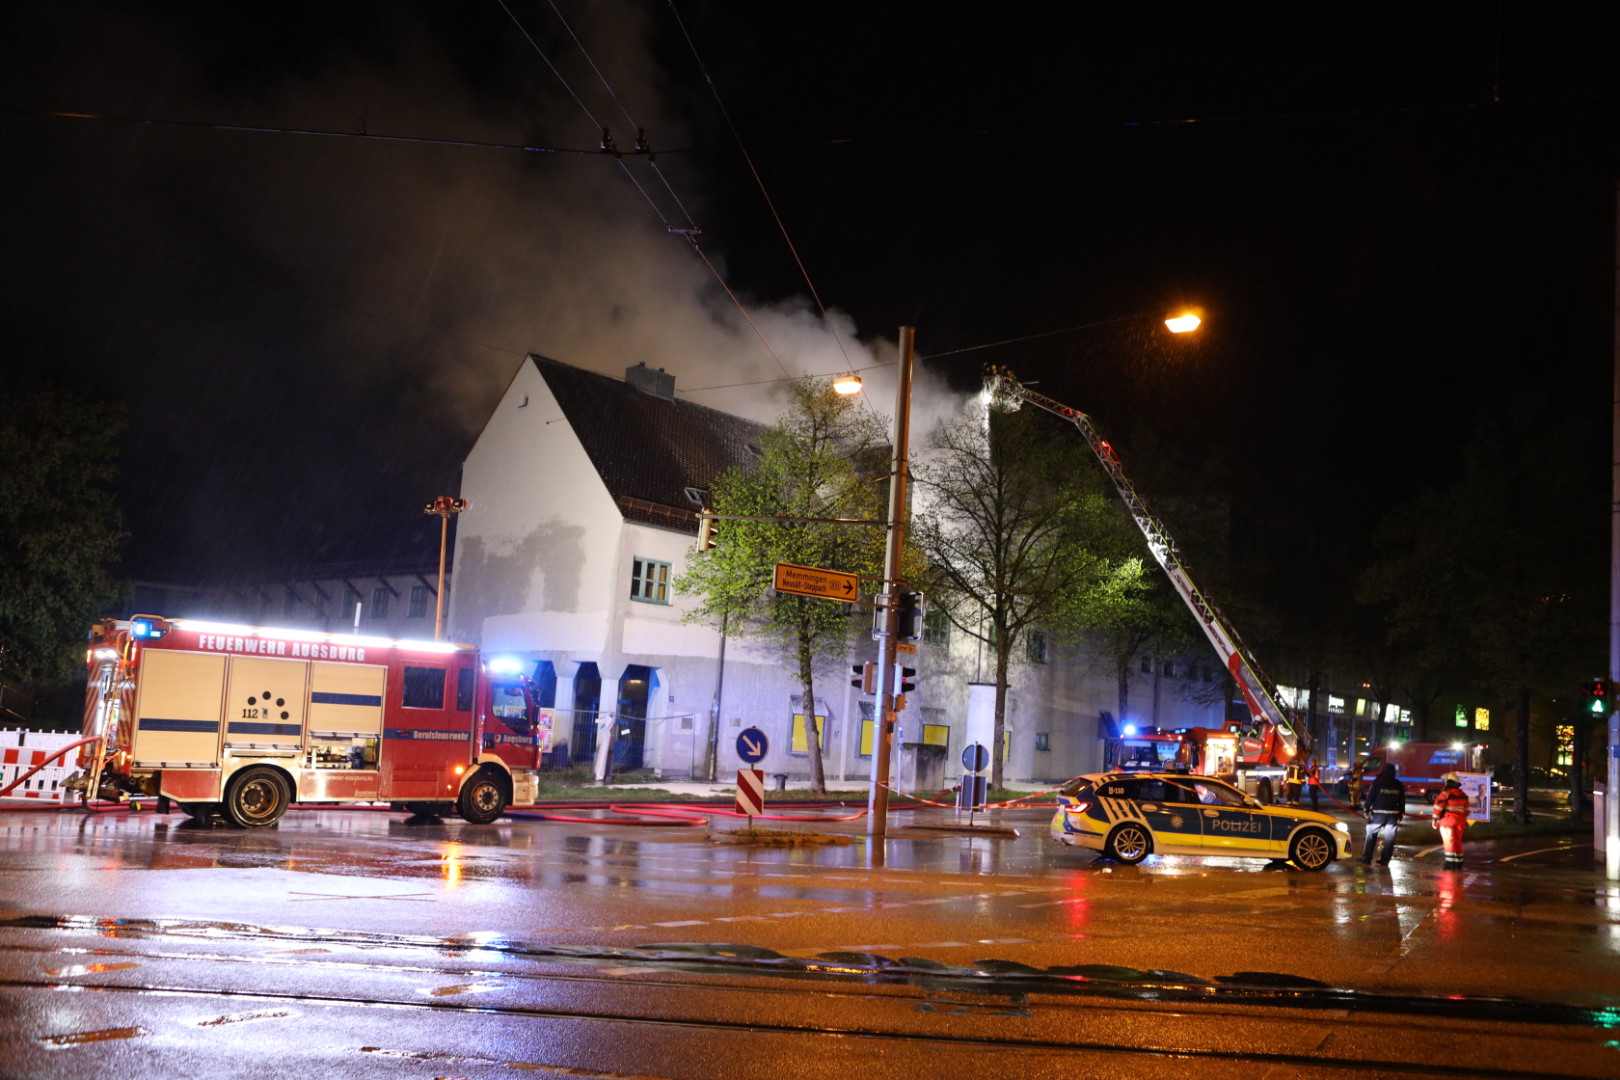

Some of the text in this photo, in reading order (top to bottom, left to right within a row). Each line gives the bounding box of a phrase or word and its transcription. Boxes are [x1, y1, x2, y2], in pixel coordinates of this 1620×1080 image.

[786, 569, 828, 584] Memmingen
[199, 634, 366, 662] FEUERWEHR AUGSBURG
[242, 708, 259, 719] 112
[413, 730, 533, 745] Berufsfeuerwehr Augsburg
[1212, 819, 1262, 833] POLIZEI
